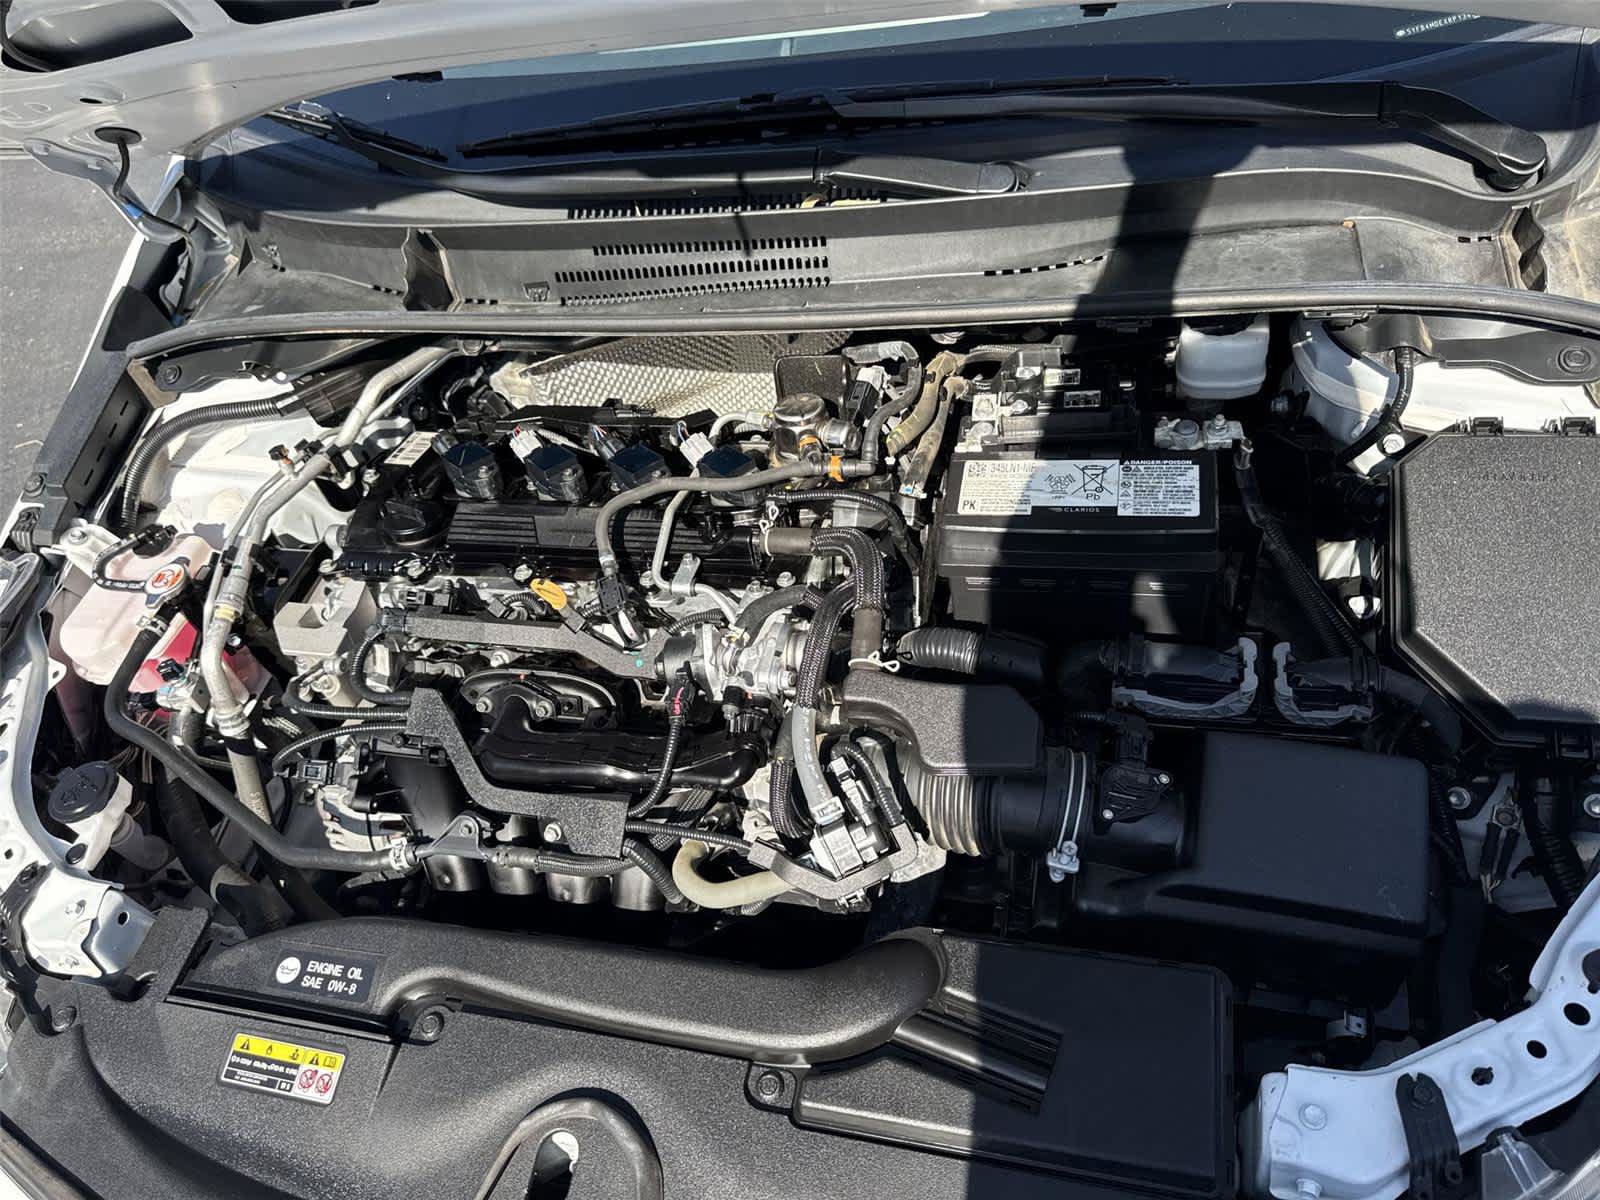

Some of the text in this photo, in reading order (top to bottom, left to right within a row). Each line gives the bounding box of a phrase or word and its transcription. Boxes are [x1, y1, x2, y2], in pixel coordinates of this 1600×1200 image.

[1085, 493, 1101, 501] Pb
[962, 500, 977, 511] PK
[307, 960, 364, 981] ENGINE OIL
[301, 975, 358, 996] SAE 0W-8
